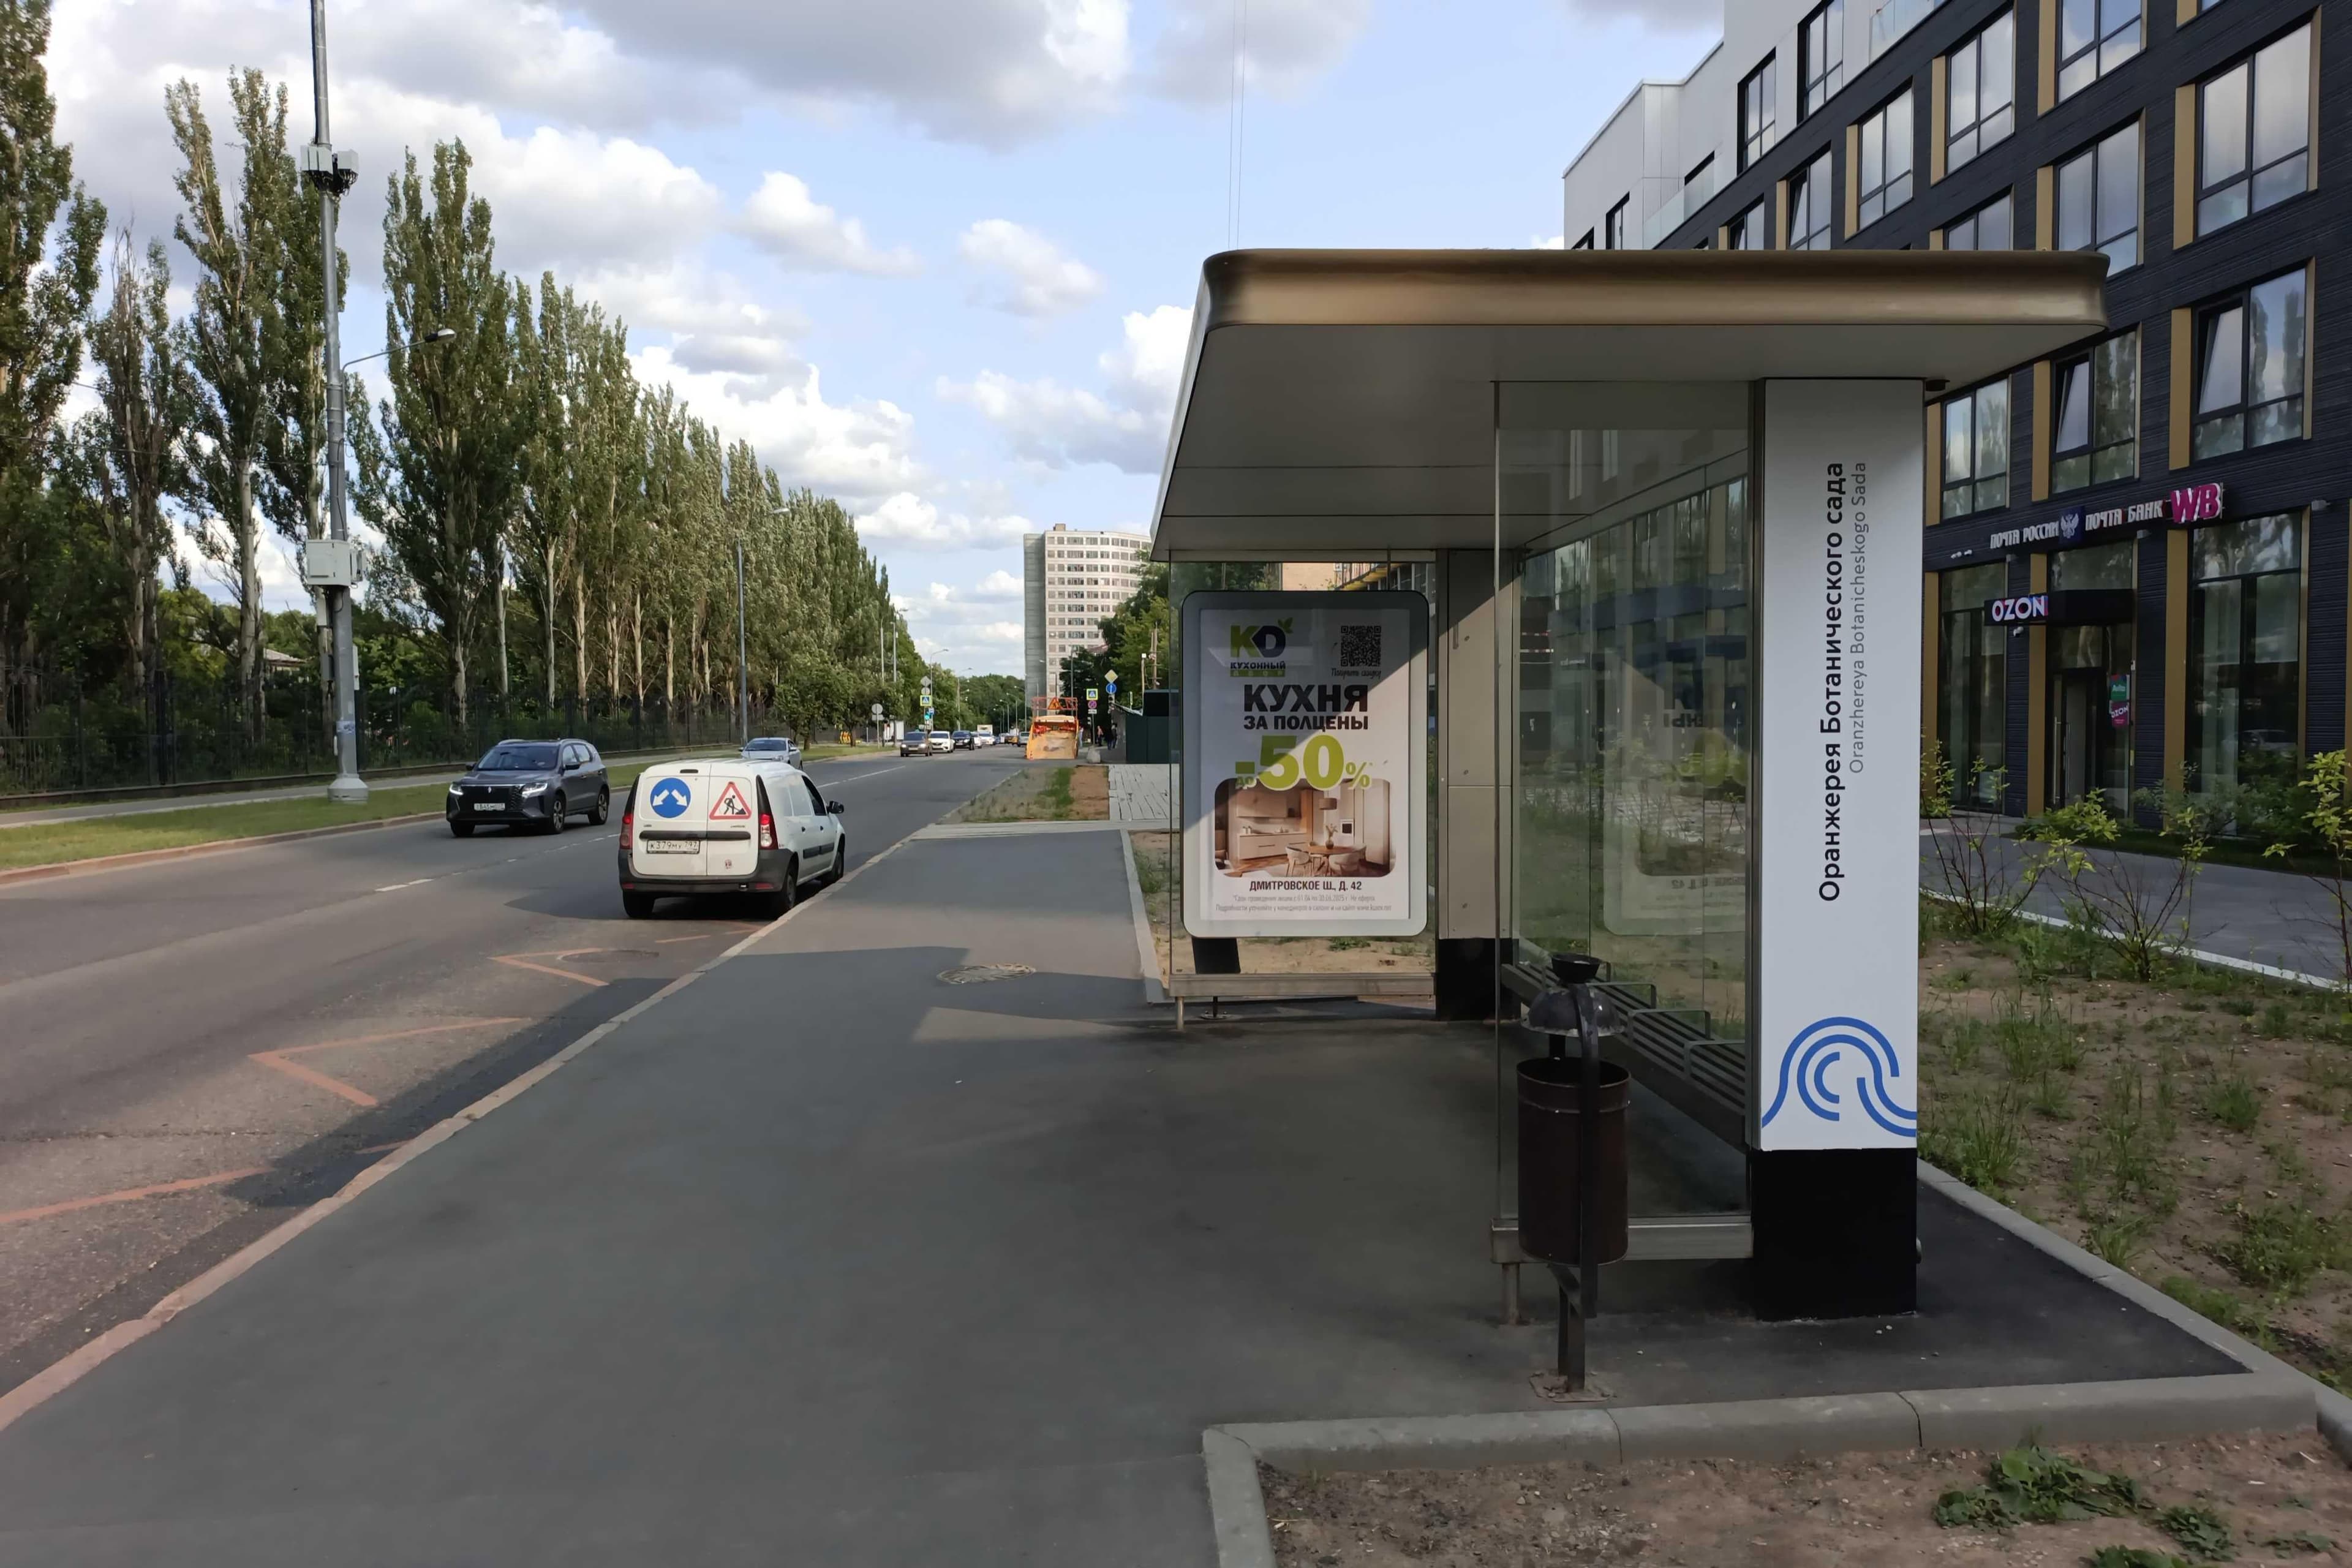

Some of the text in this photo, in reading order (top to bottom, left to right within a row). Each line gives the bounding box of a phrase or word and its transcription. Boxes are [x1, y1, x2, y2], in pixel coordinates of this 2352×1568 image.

[2085, 499, 2164, 531] ПОЧТА БАНК
[2170, 483, 2221, 524] WB
[1990, 521, 2060, 549] ПОЧТА РОССИИ
[1849, 462, 1869, 774] Oranzhereya Botanicheskogo Sada
[1992, 595, 2046, 622] OZON
[1230, 660, 1286, 669] КУХОННЫЙ
[1819, 463, 1846, 901] Оранжерея Ботанического сада
[1244, 684, 1368, 712] КУХНЯ
[2111, 704, 2128, 718] OZON
[1243, 715, 1368, 732] ЗА ПОЛЦЕНЫ
[1250, 880, 1320, 891] ДМИТРОВСКОЕ
[1339, 880, 1348, 891] Д.
[1351, 881, 1362, 891] 42
